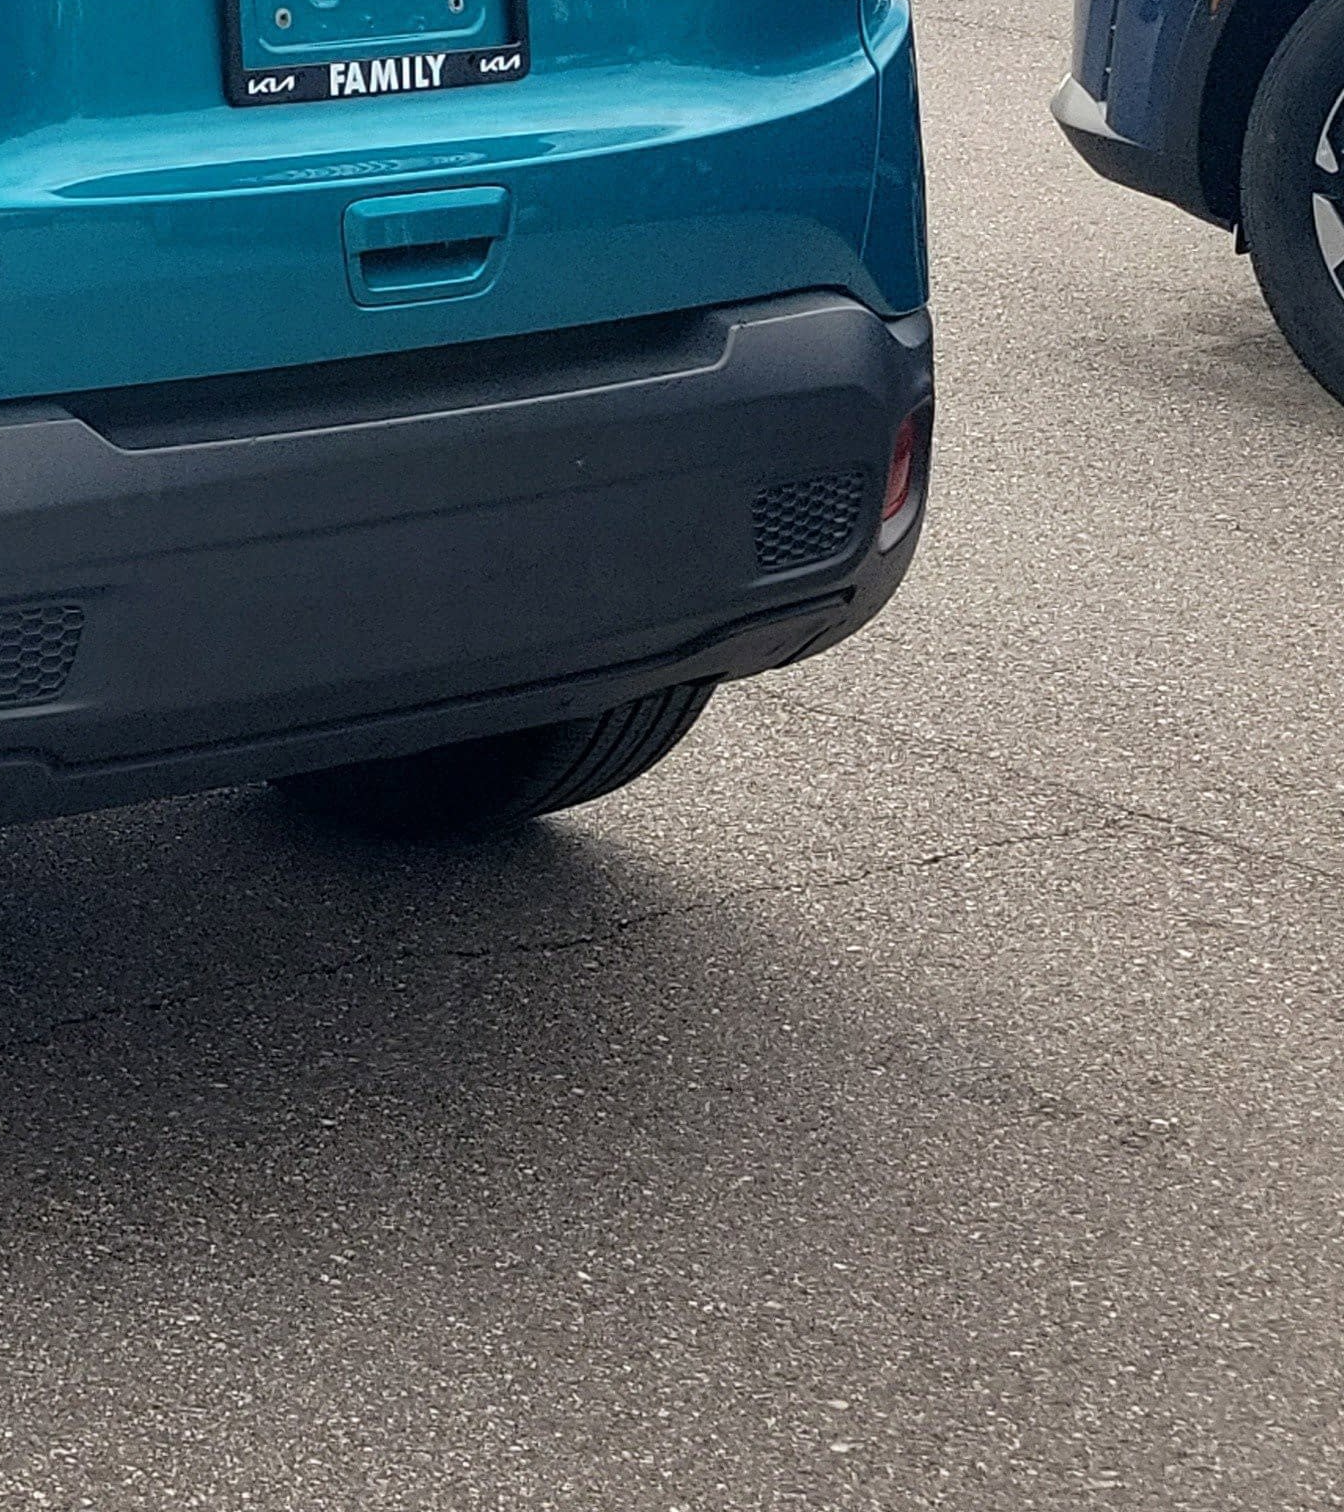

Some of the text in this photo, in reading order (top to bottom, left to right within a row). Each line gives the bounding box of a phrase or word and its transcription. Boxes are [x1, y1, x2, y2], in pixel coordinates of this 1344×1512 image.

[247, 53, 521, 97] KIA FAMILY KIA
